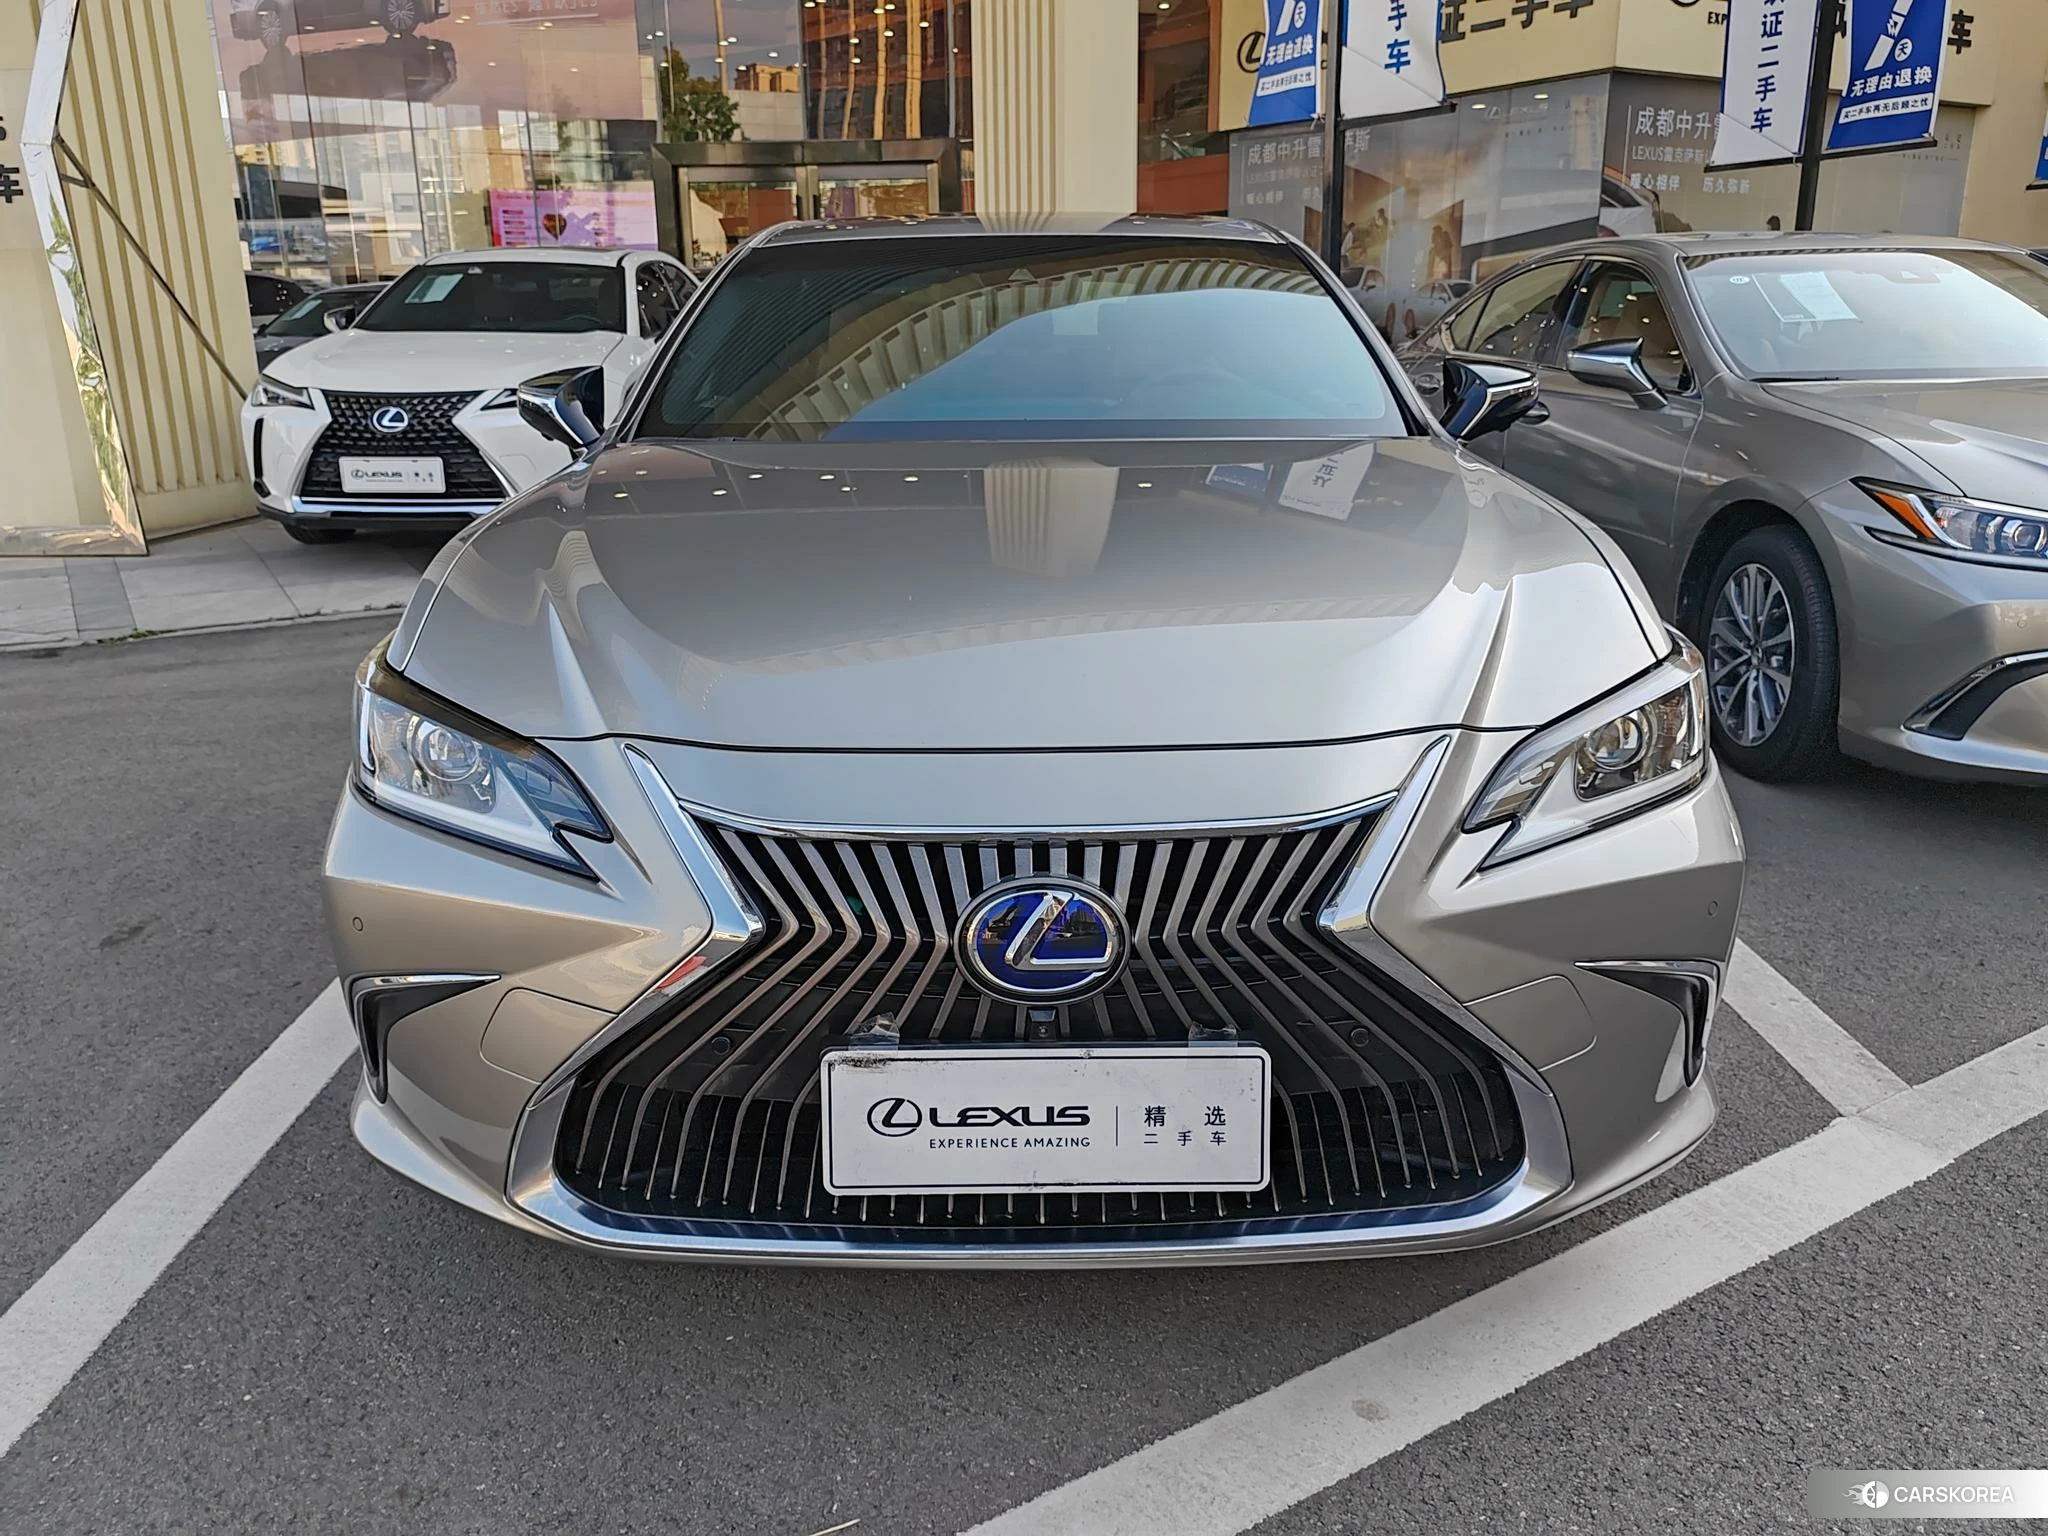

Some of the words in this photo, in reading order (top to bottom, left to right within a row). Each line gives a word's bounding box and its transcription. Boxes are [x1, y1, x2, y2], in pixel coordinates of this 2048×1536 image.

[1897, 41, 1909, 58] 天
[1750, 0, 1784, 133] 证二手车
[1850, 65, 1933, 98] 无理由退换
[929, 1106, 1090, 1127] LEXUS
[929, 1138, 1018, 1149] EXPERIENCE
[1024, 1137, 1091, 1148] AMAZING
